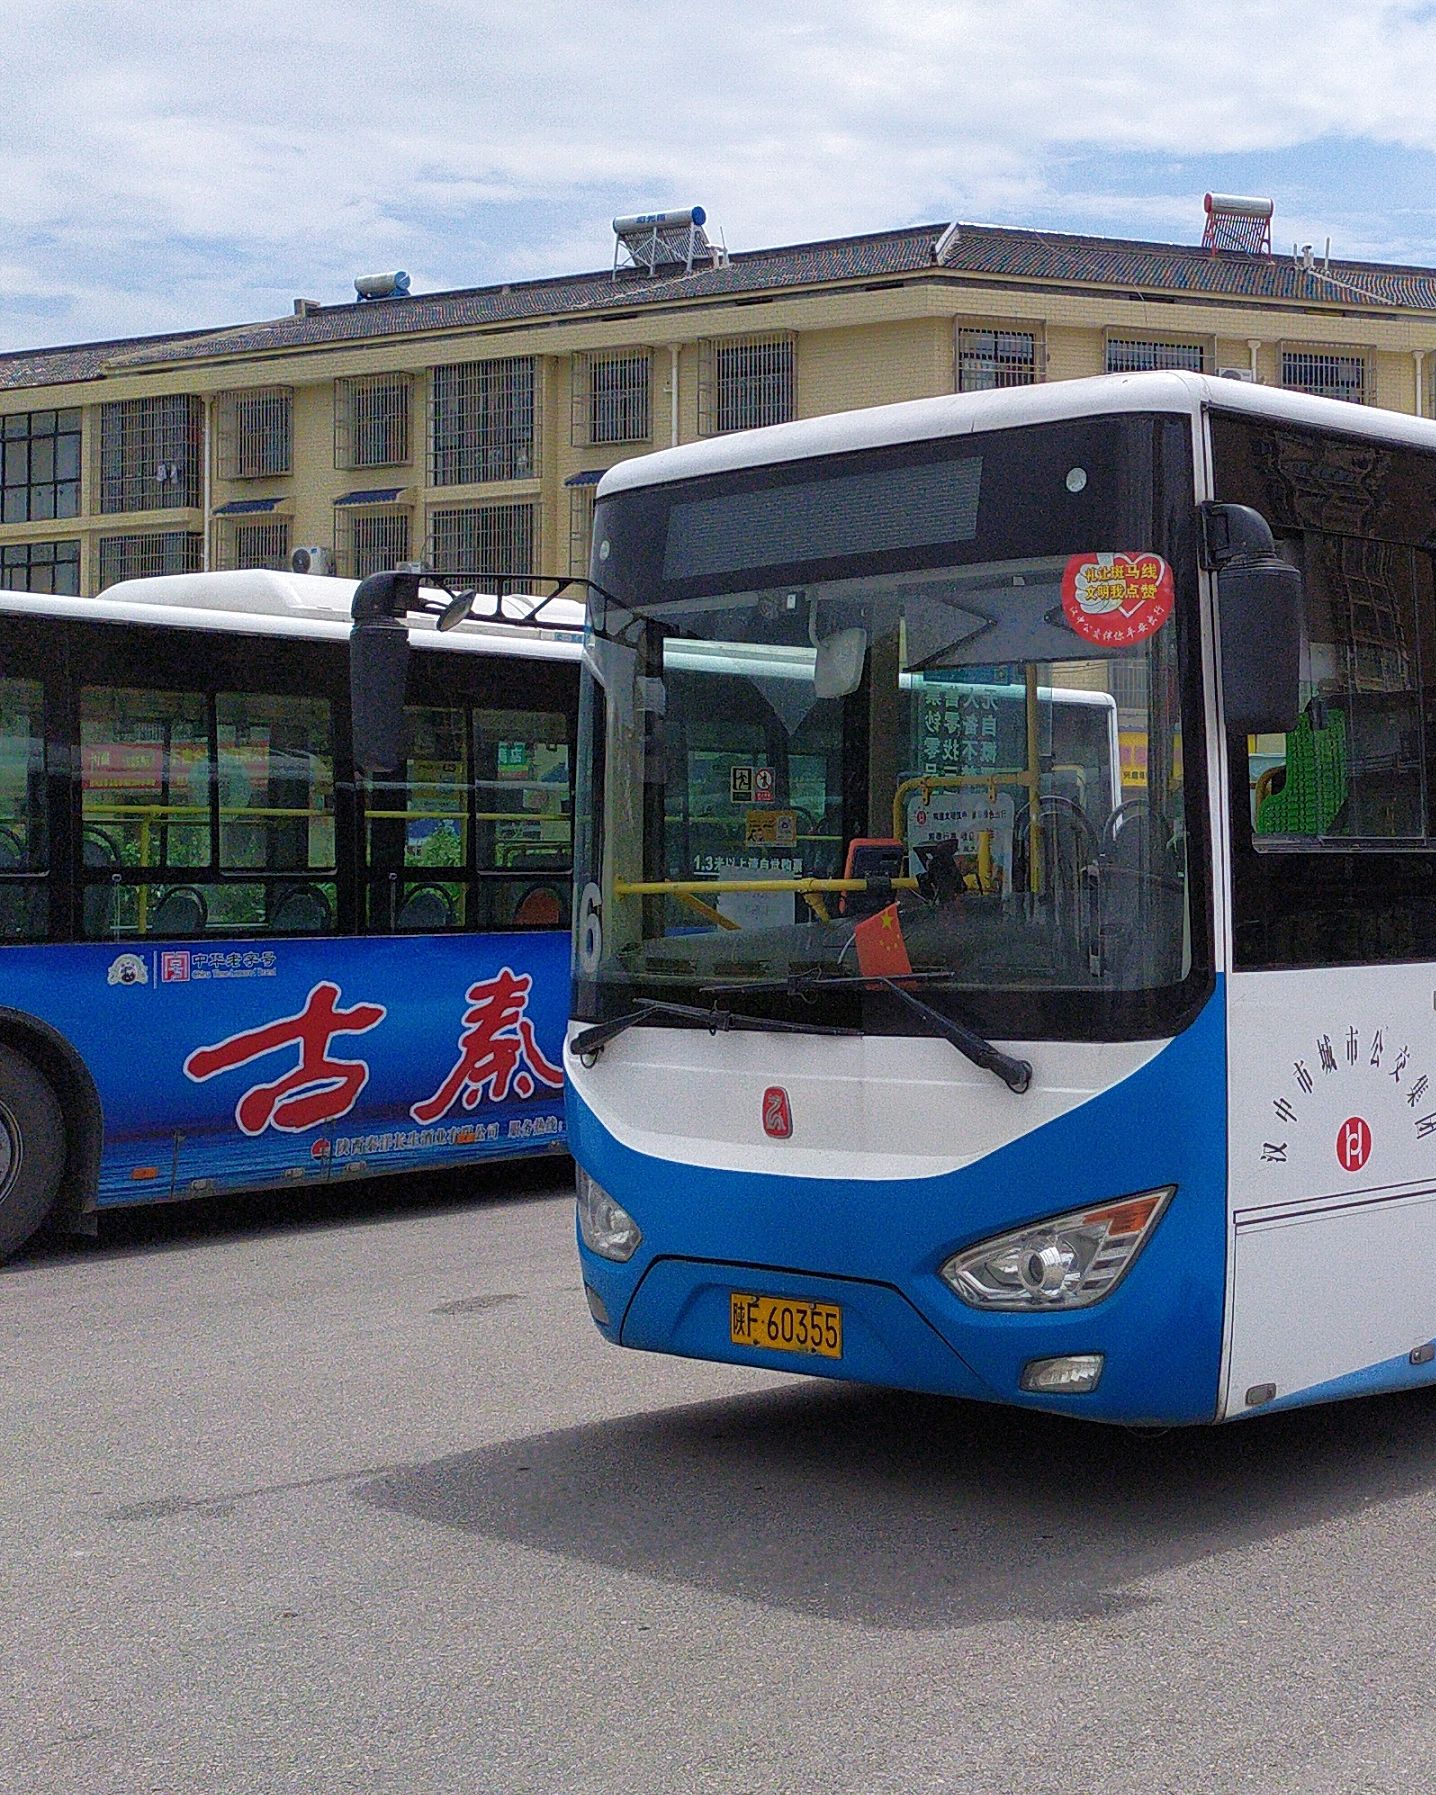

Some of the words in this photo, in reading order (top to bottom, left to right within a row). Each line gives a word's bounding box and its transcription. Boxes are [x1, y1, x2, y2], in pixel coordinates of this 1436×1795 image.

[1085, 563, 1158, 582] 礼让斑马线
[1085, 583, 1158, 601] 文明我点赞
[191, 951, 277, 969] 中华老字号
